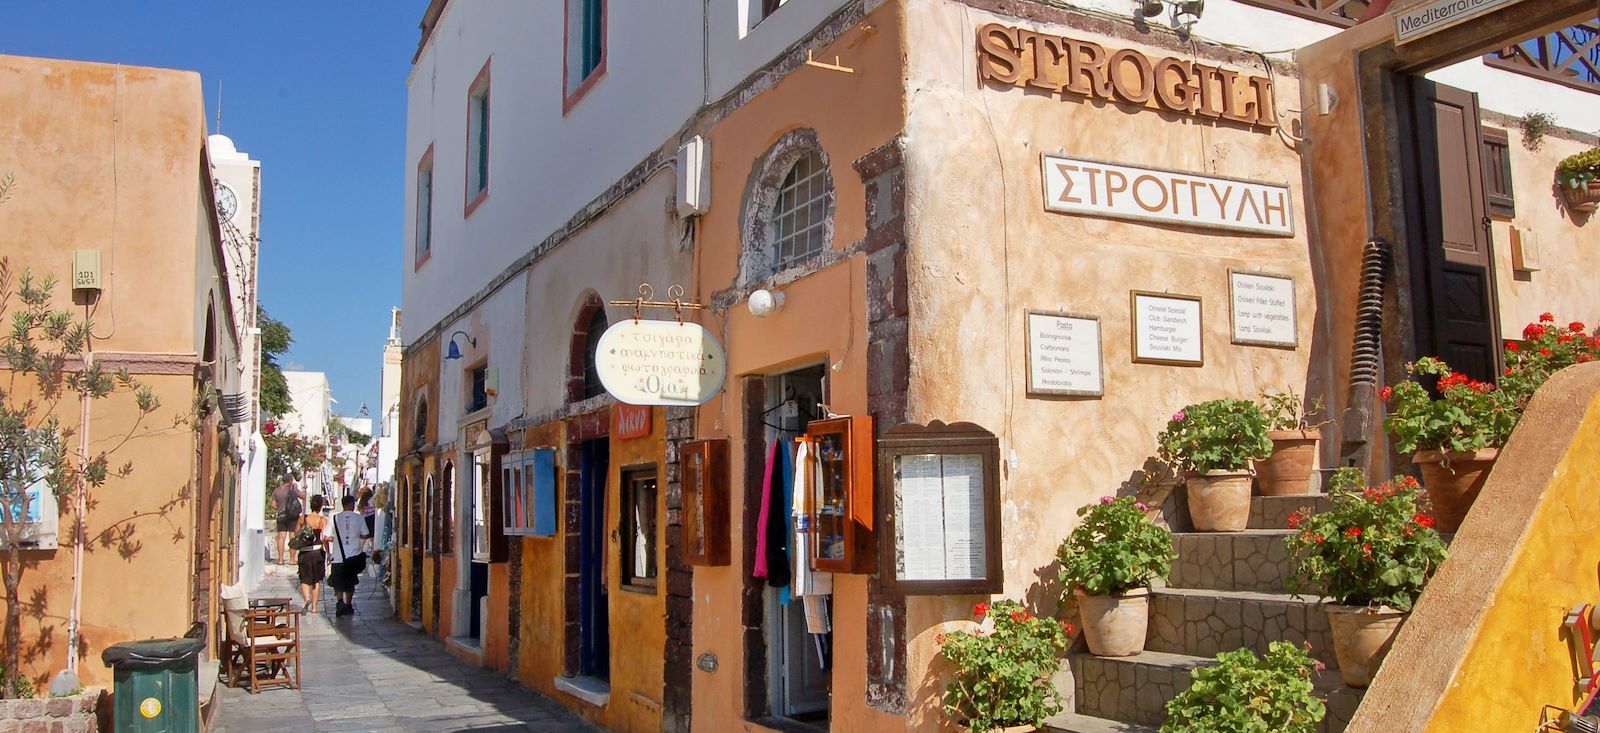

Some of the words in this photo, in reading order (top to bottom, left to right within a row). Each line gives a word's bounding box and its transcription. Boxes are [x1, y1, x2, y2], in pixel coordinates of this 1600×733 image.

[978, 23, 1276, 127] STROGILI
[1055, 163, 1286, 227] ΣΤΡΟΓΓΥΛΗ
[1056, 320, 1073, 329] Pasta
